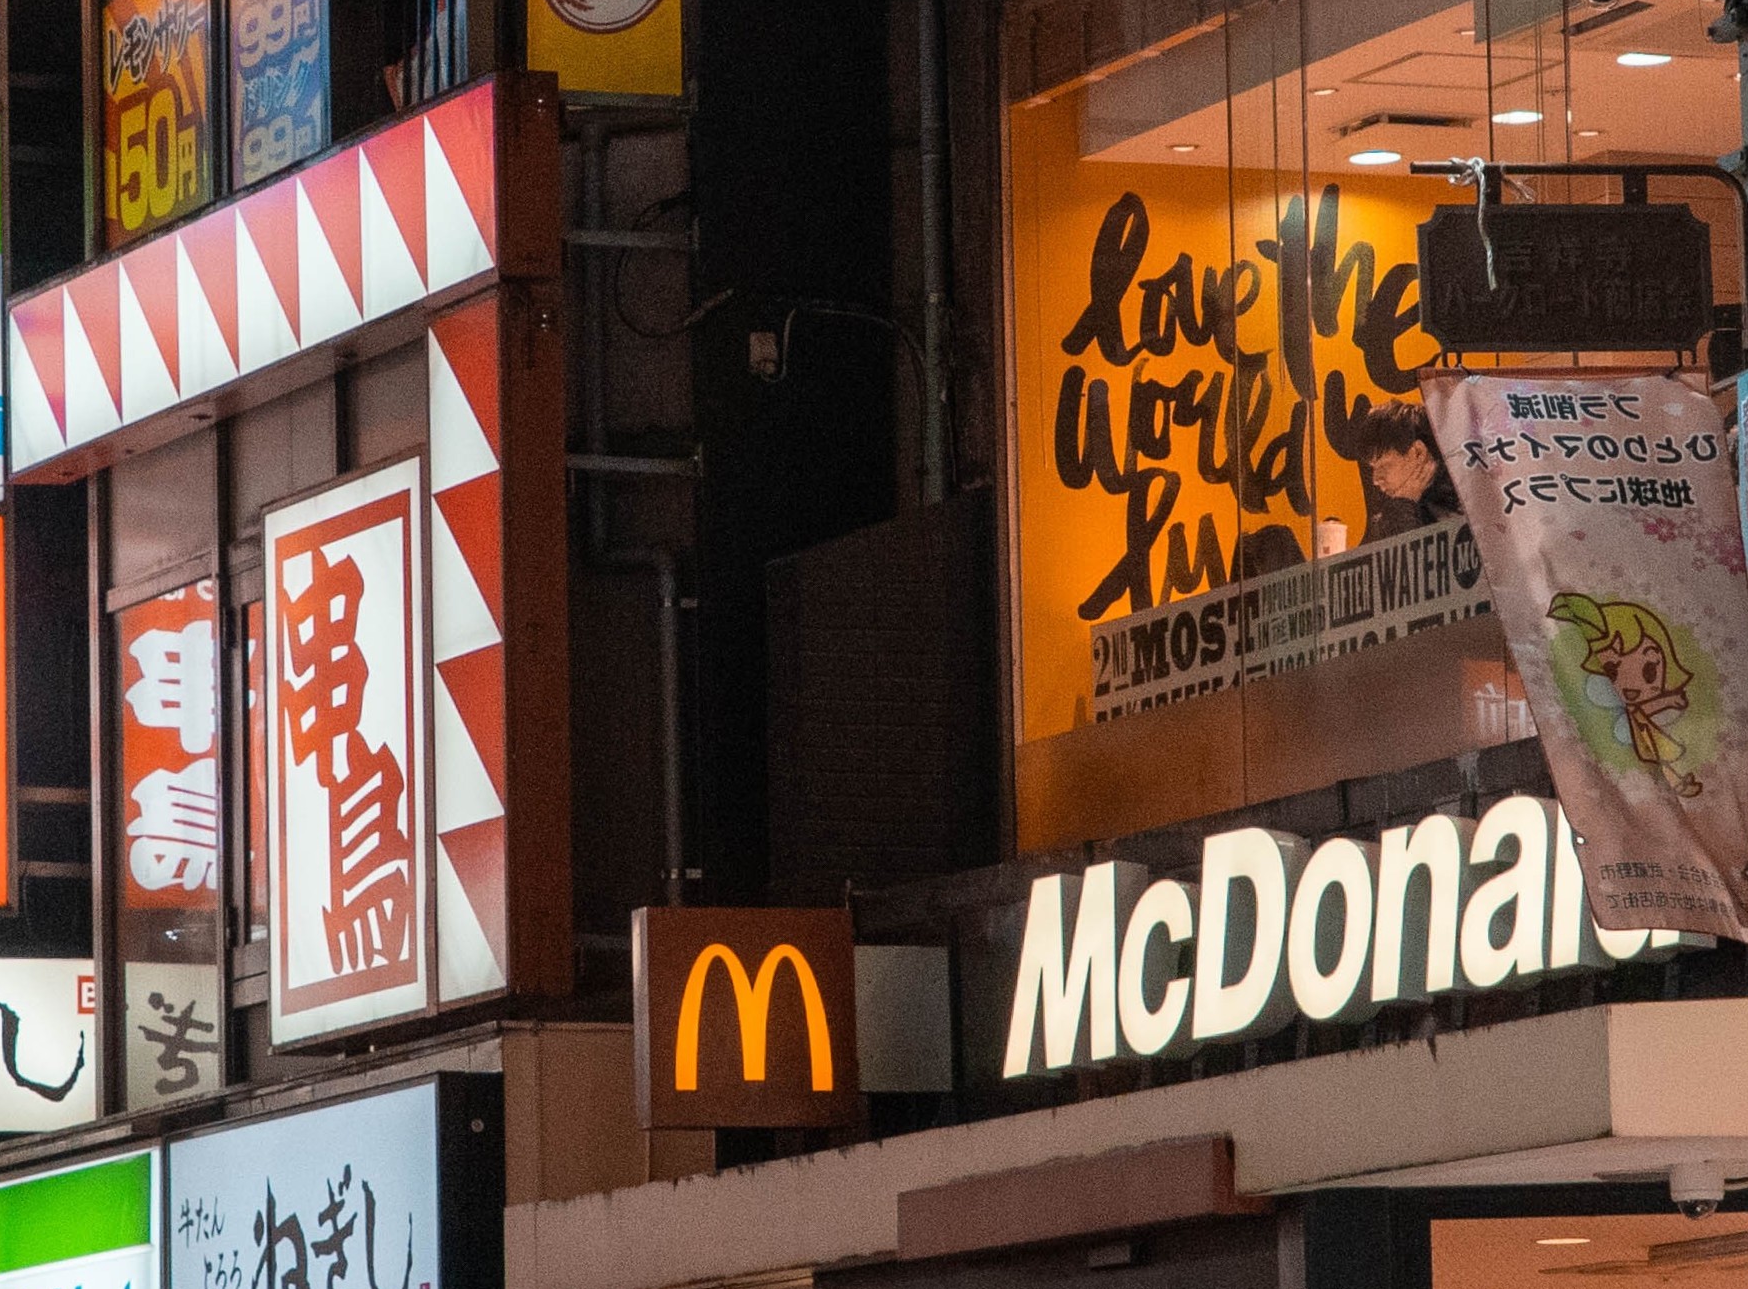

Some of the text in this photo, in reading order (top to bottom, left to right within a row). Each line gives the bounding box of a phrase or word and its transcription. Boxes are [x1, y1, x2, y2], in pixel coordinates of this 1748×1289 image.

[1130, 590, 1260, 688] MOST
[1375, 530, 1451, 613] WATER
[282, 540, 410, 977] 串鳥
[178, 1196, 225, 1252] 牛たん
